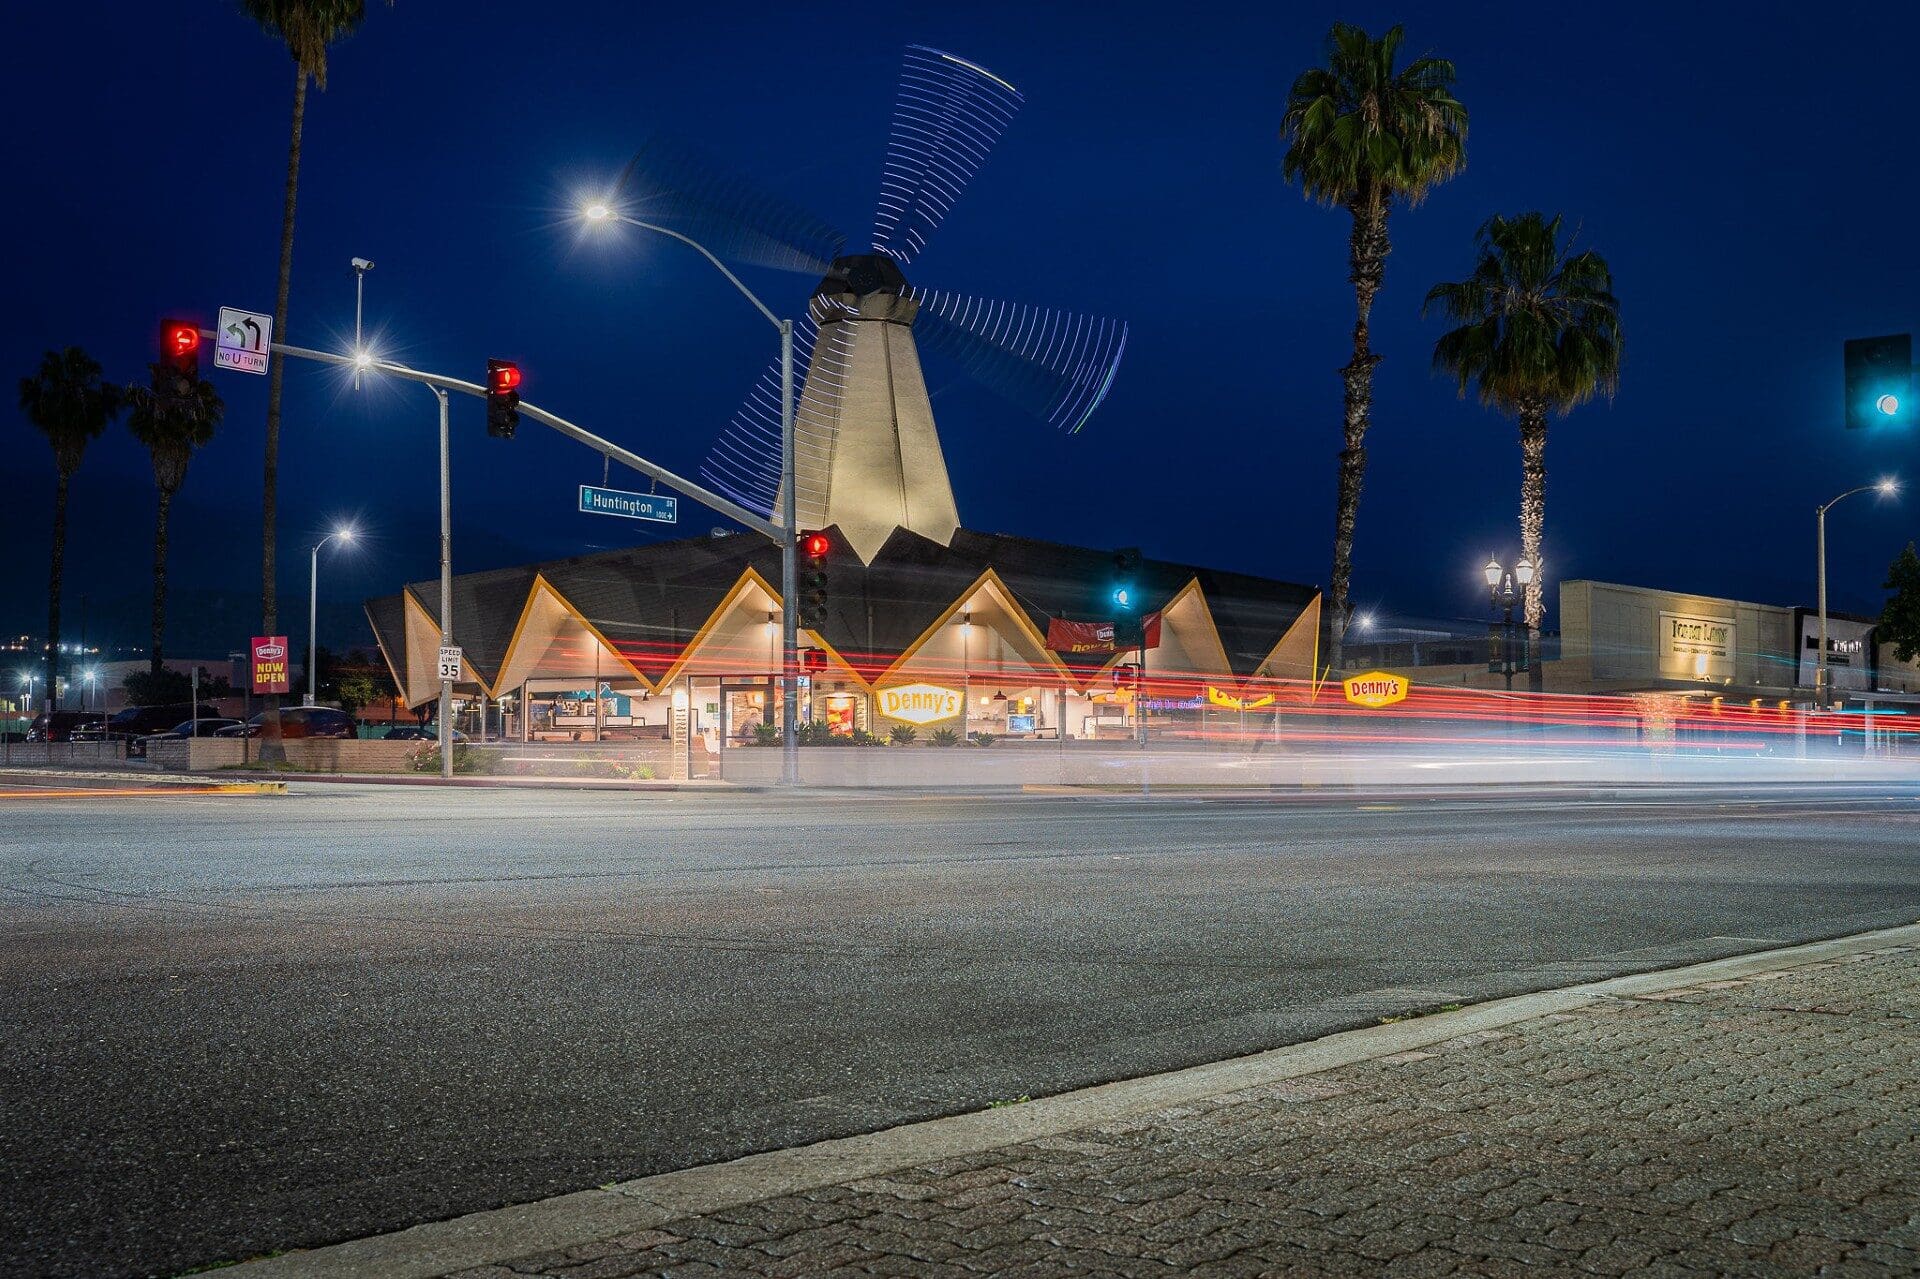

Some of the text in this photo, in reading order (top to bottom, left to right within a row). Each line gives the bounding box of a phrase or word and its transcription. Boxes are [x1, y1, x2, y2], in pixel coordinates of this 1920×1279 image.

[219, 352, 264, 367] NO U TURN
[593, 494, 652, 515] Huntington
[256, 663, 284, 673] NOW
[441, 664, 458, 677] 35
[256, 673, 285, 683] OPEN
[1351, 680, 1399, 697] Denny's
[887, 690, 955, 714] Denny's
